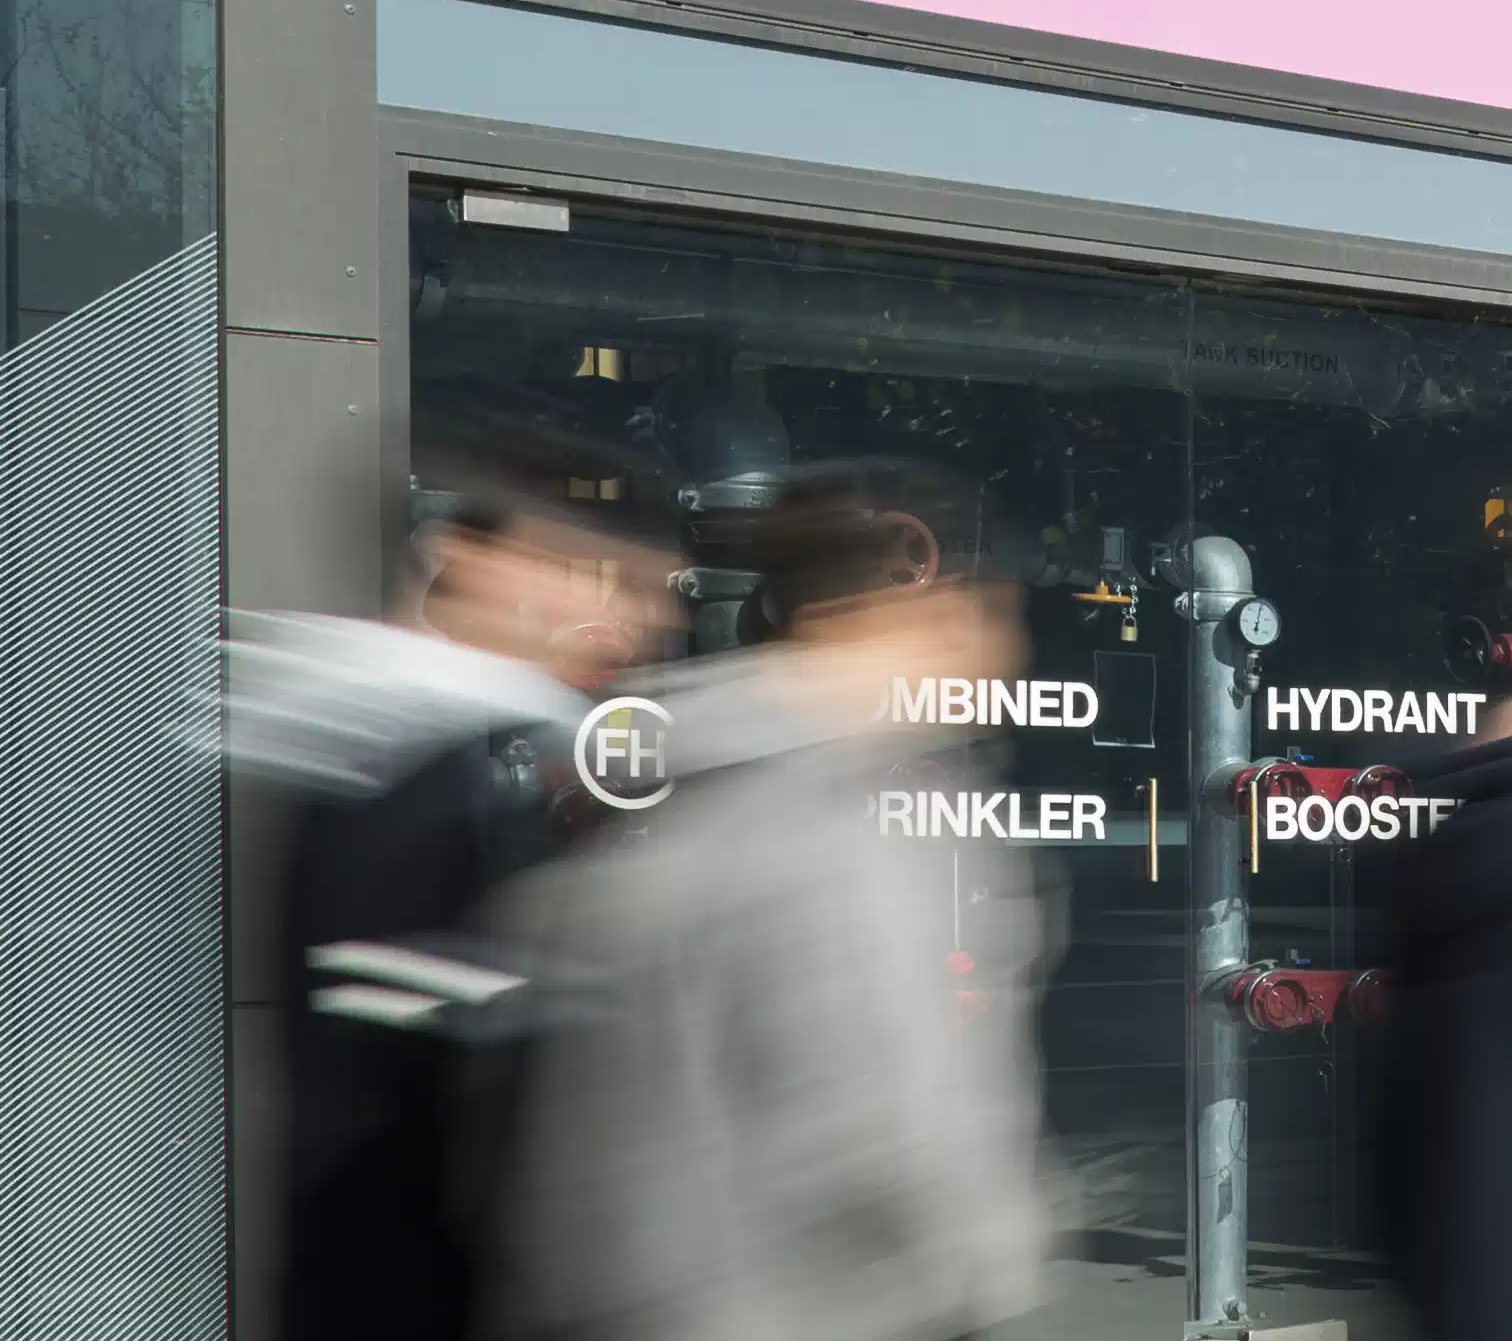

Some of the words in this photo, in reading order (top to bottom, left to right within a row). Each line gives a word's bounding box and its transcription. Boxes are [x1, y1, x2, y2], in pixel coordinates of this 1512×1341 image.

[867, 677, 1099, 728] MBINED
[1267, 687, 1486, 734] HYDRANT
[595, 728, 666, 779] FH
[866, 791, 1106, 840] RINKLER
[1266, 795, 1467, 841] BOOSTE
